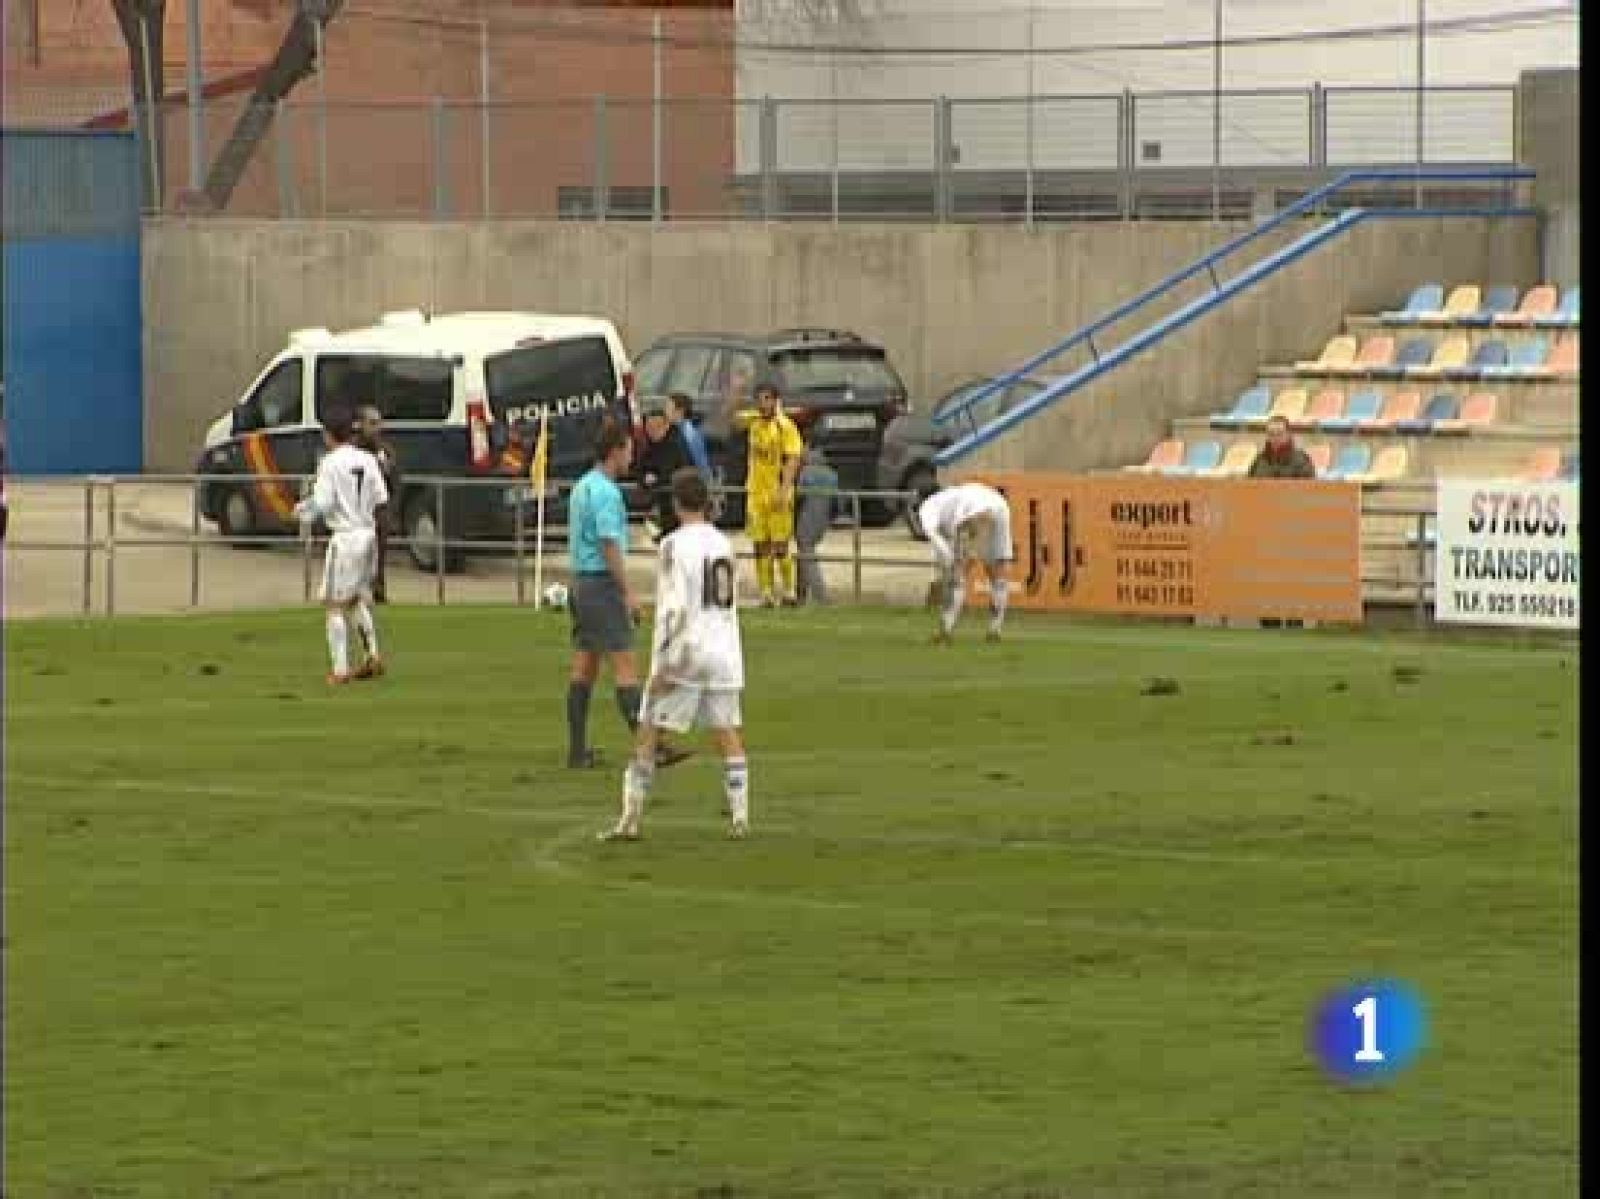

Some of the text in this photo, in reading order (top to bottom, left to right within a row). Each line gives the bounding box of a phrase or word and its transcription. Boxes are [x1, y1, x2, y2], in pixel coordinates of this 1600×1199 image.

[506, 390, 606, 425] POLICIA
[349, 465, 365, 500] 7
[1110, 498, 1193, 530] export
[703, 555, 734, 610] 10
